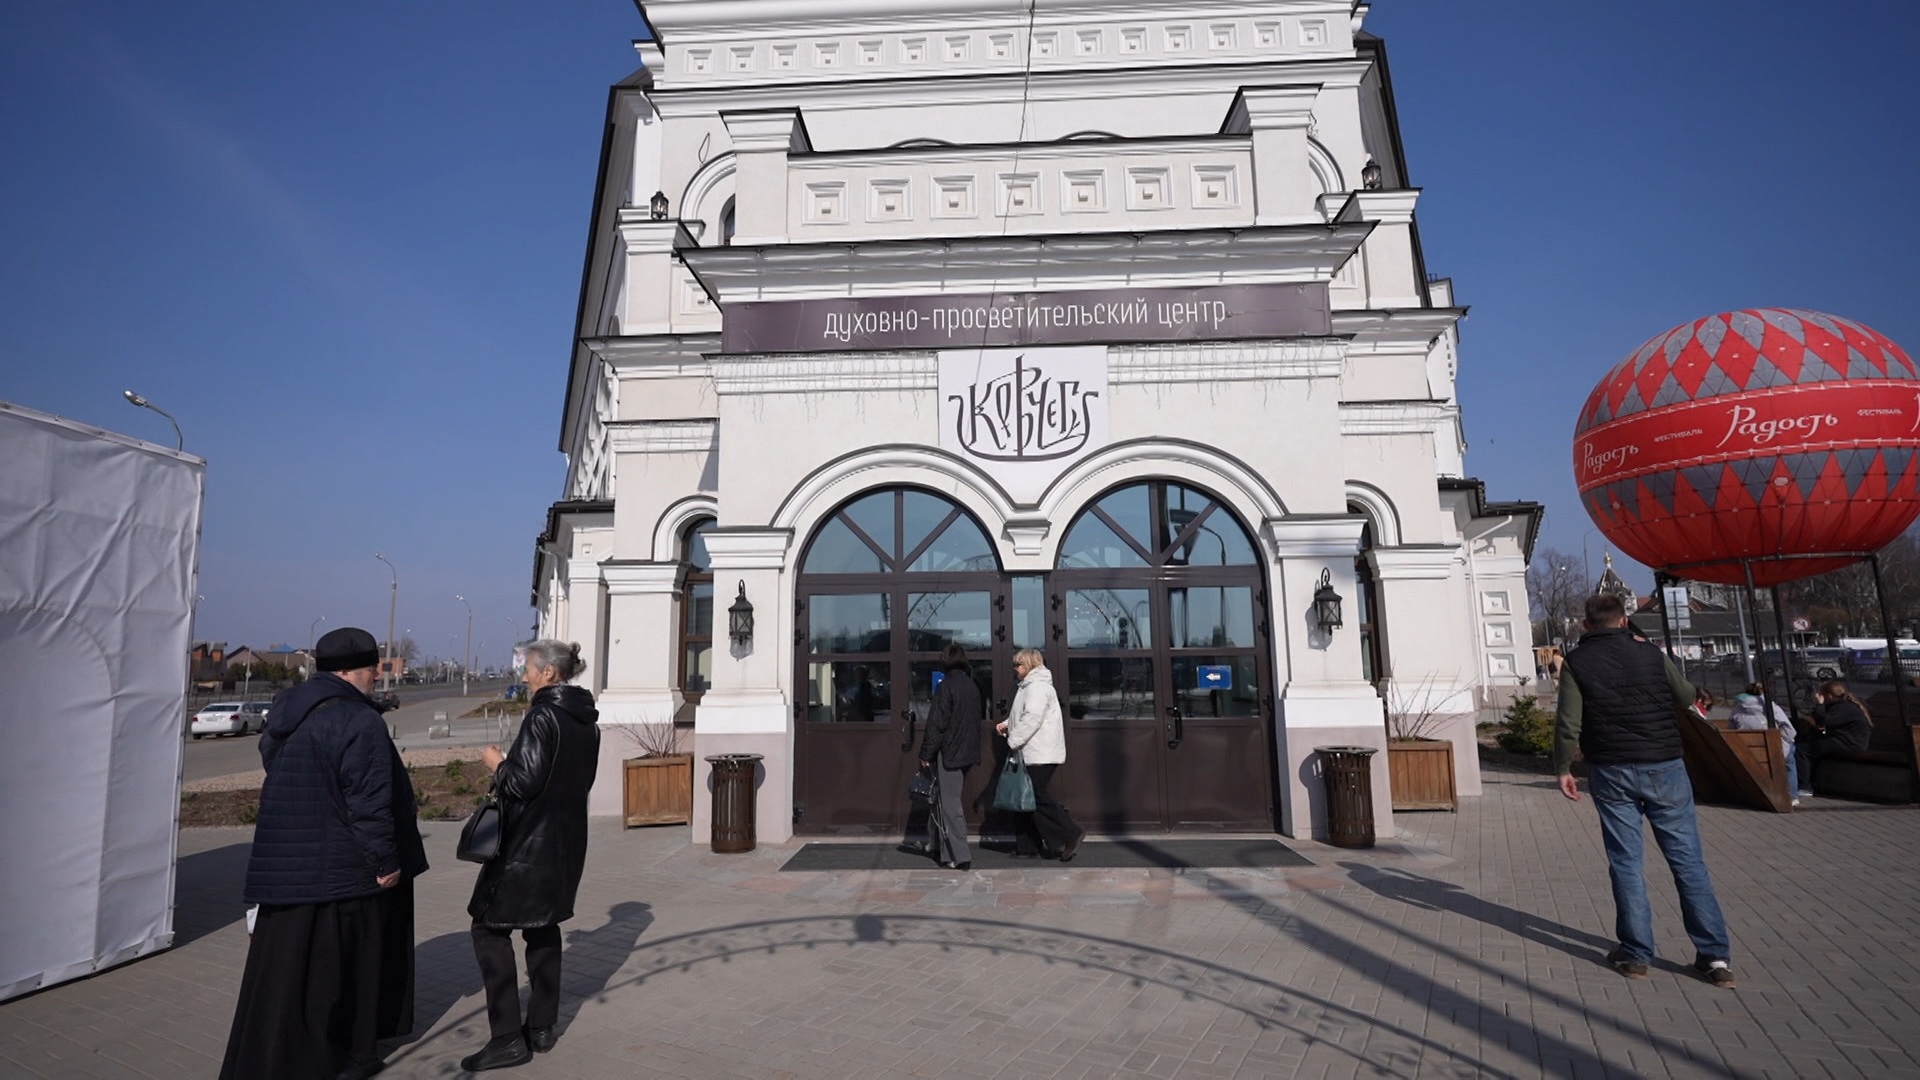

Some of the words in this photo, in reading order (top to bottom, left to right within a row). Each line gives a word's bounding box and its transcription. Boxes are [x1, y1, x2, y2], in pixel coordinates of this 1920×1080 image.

[824, 297, 1148, 342] духовно-просветительский
[1158, 301, 1226, 330] центр
[1582, 441, 1639, 479] Радость
[1716, 405, 1838, 448] Радость
